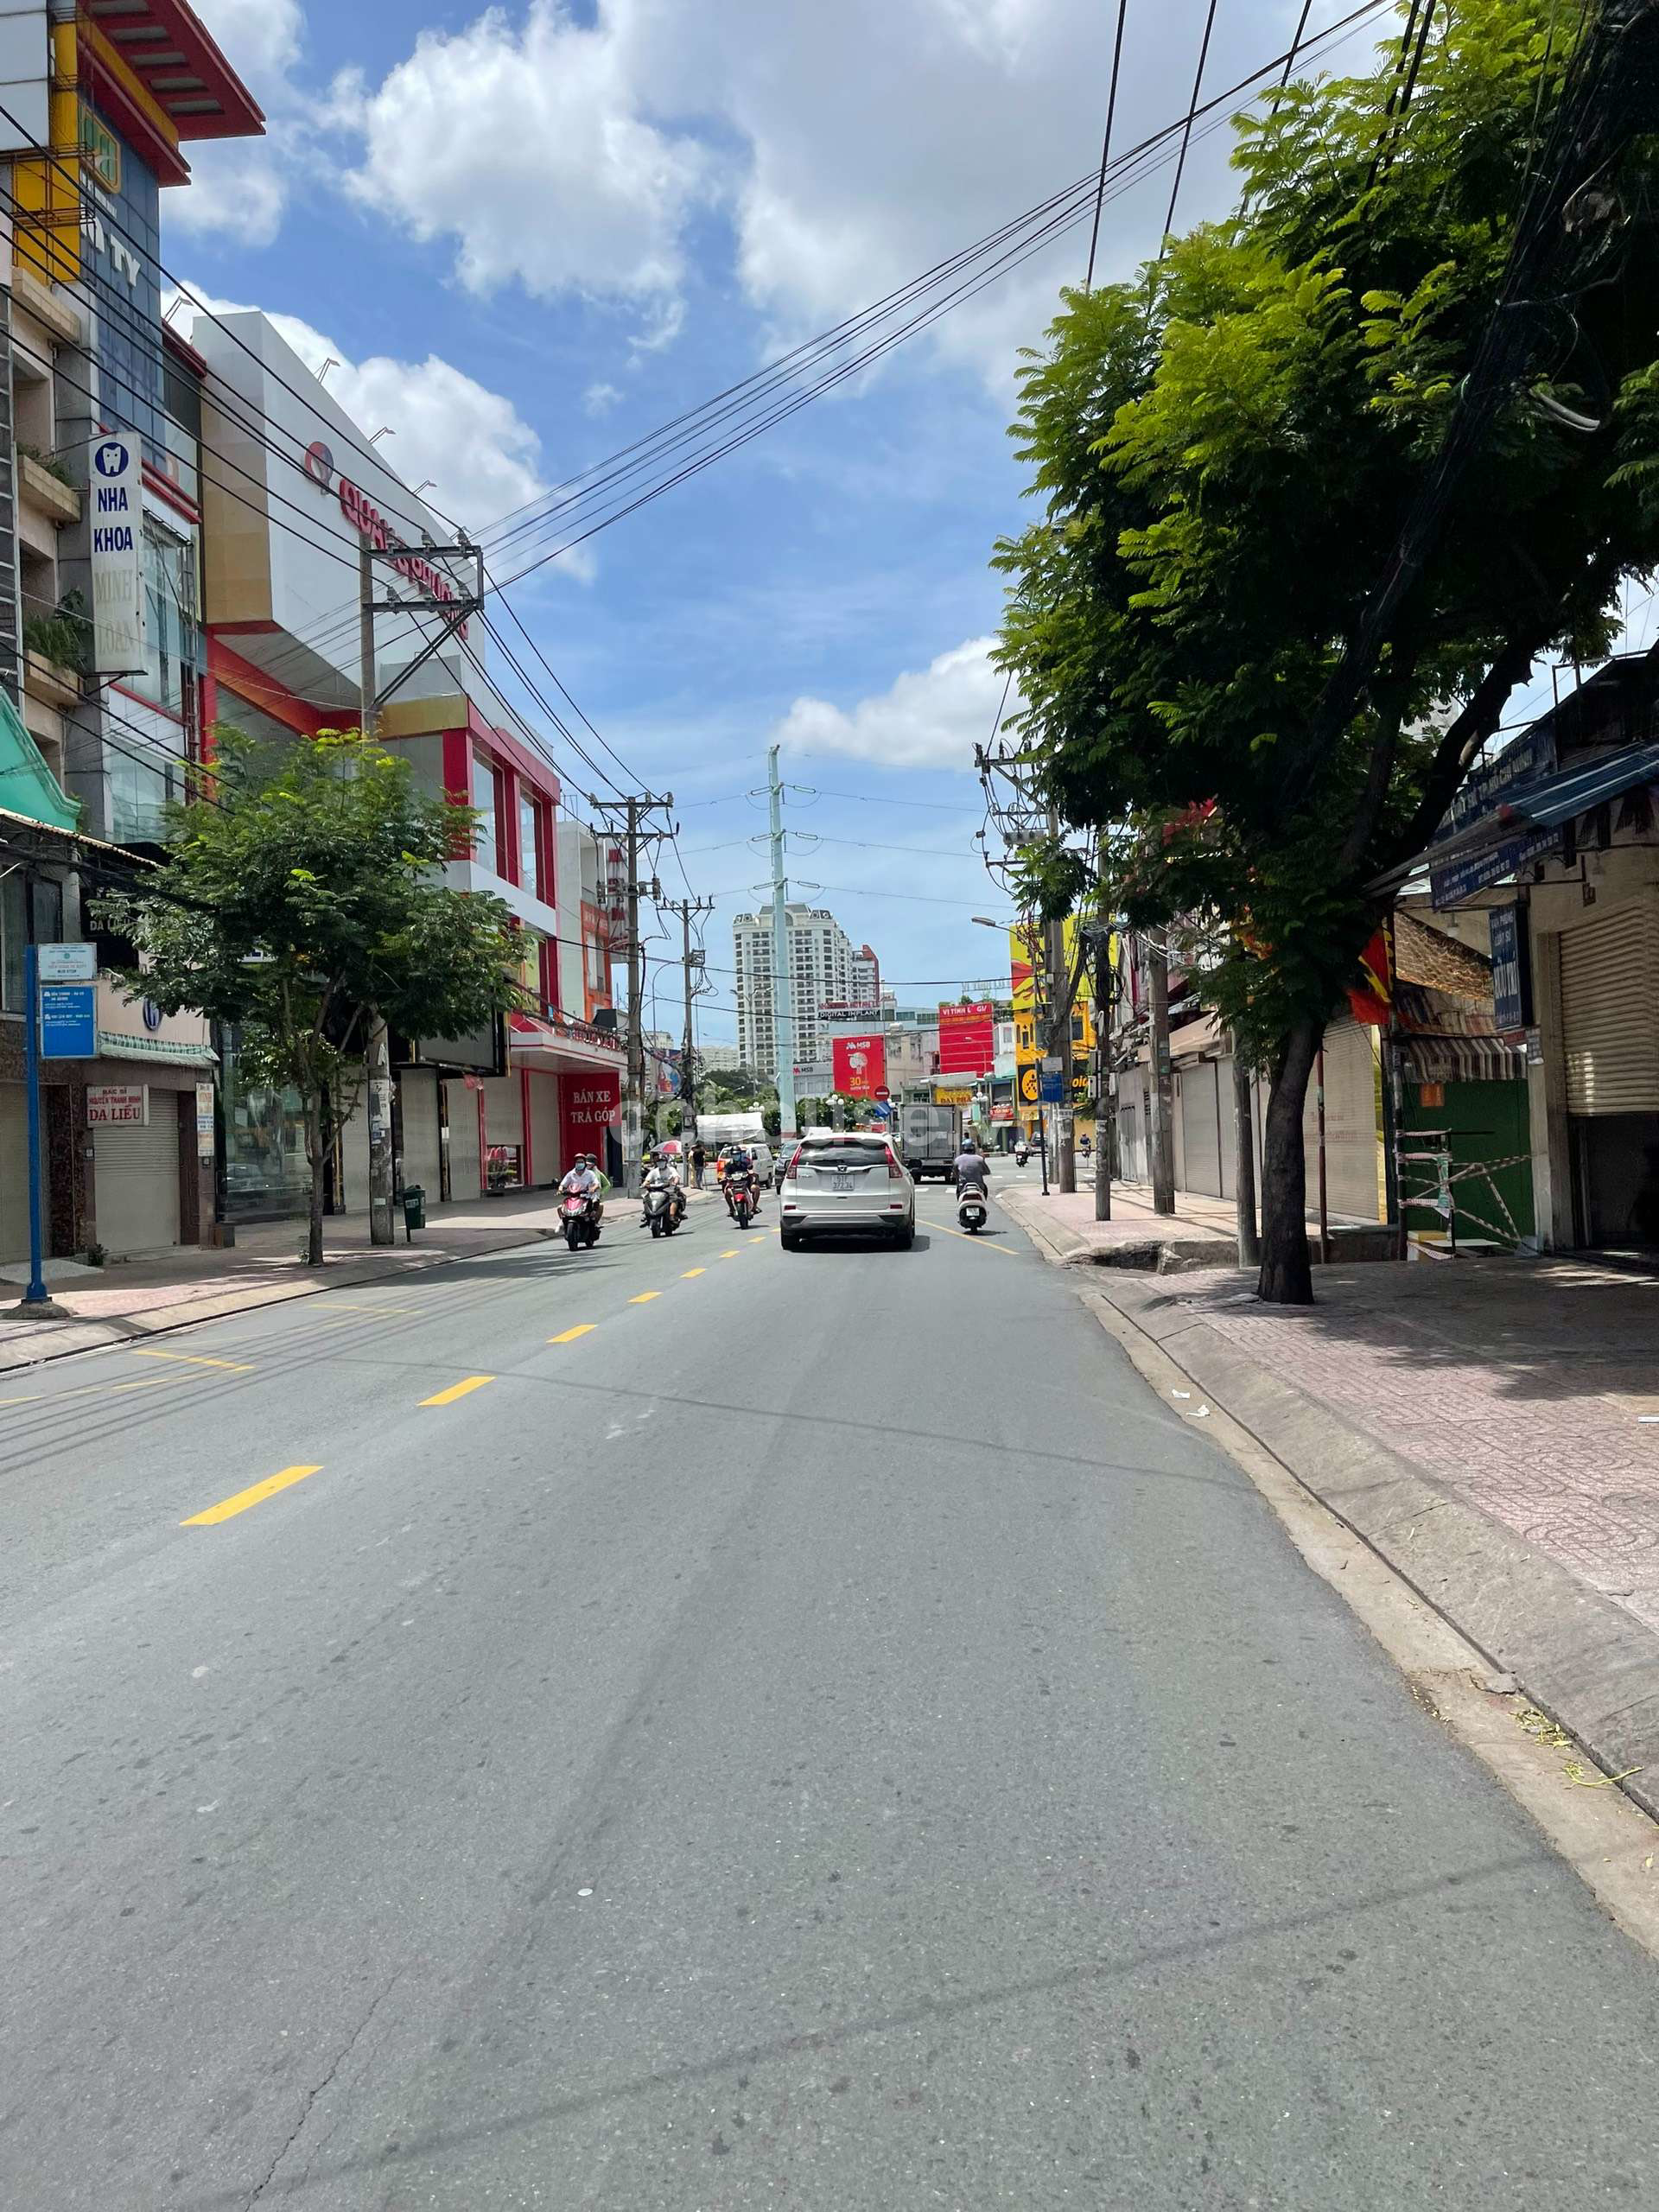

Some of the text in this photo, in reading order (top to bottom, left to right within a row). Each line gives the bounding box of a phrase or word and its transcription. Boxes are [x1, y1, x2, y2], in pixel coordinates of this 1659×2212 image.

[98, 486, 129, 513] NHA
[94, 525, 134, 553] KHOA
[849, 1077, 861, 1087] 30
[574, 1088, 611, 1103] BÁN XE
[90, 1109, 107, 1122] DA
[571, 1106, 615, 1123] TRẢ GÓP
